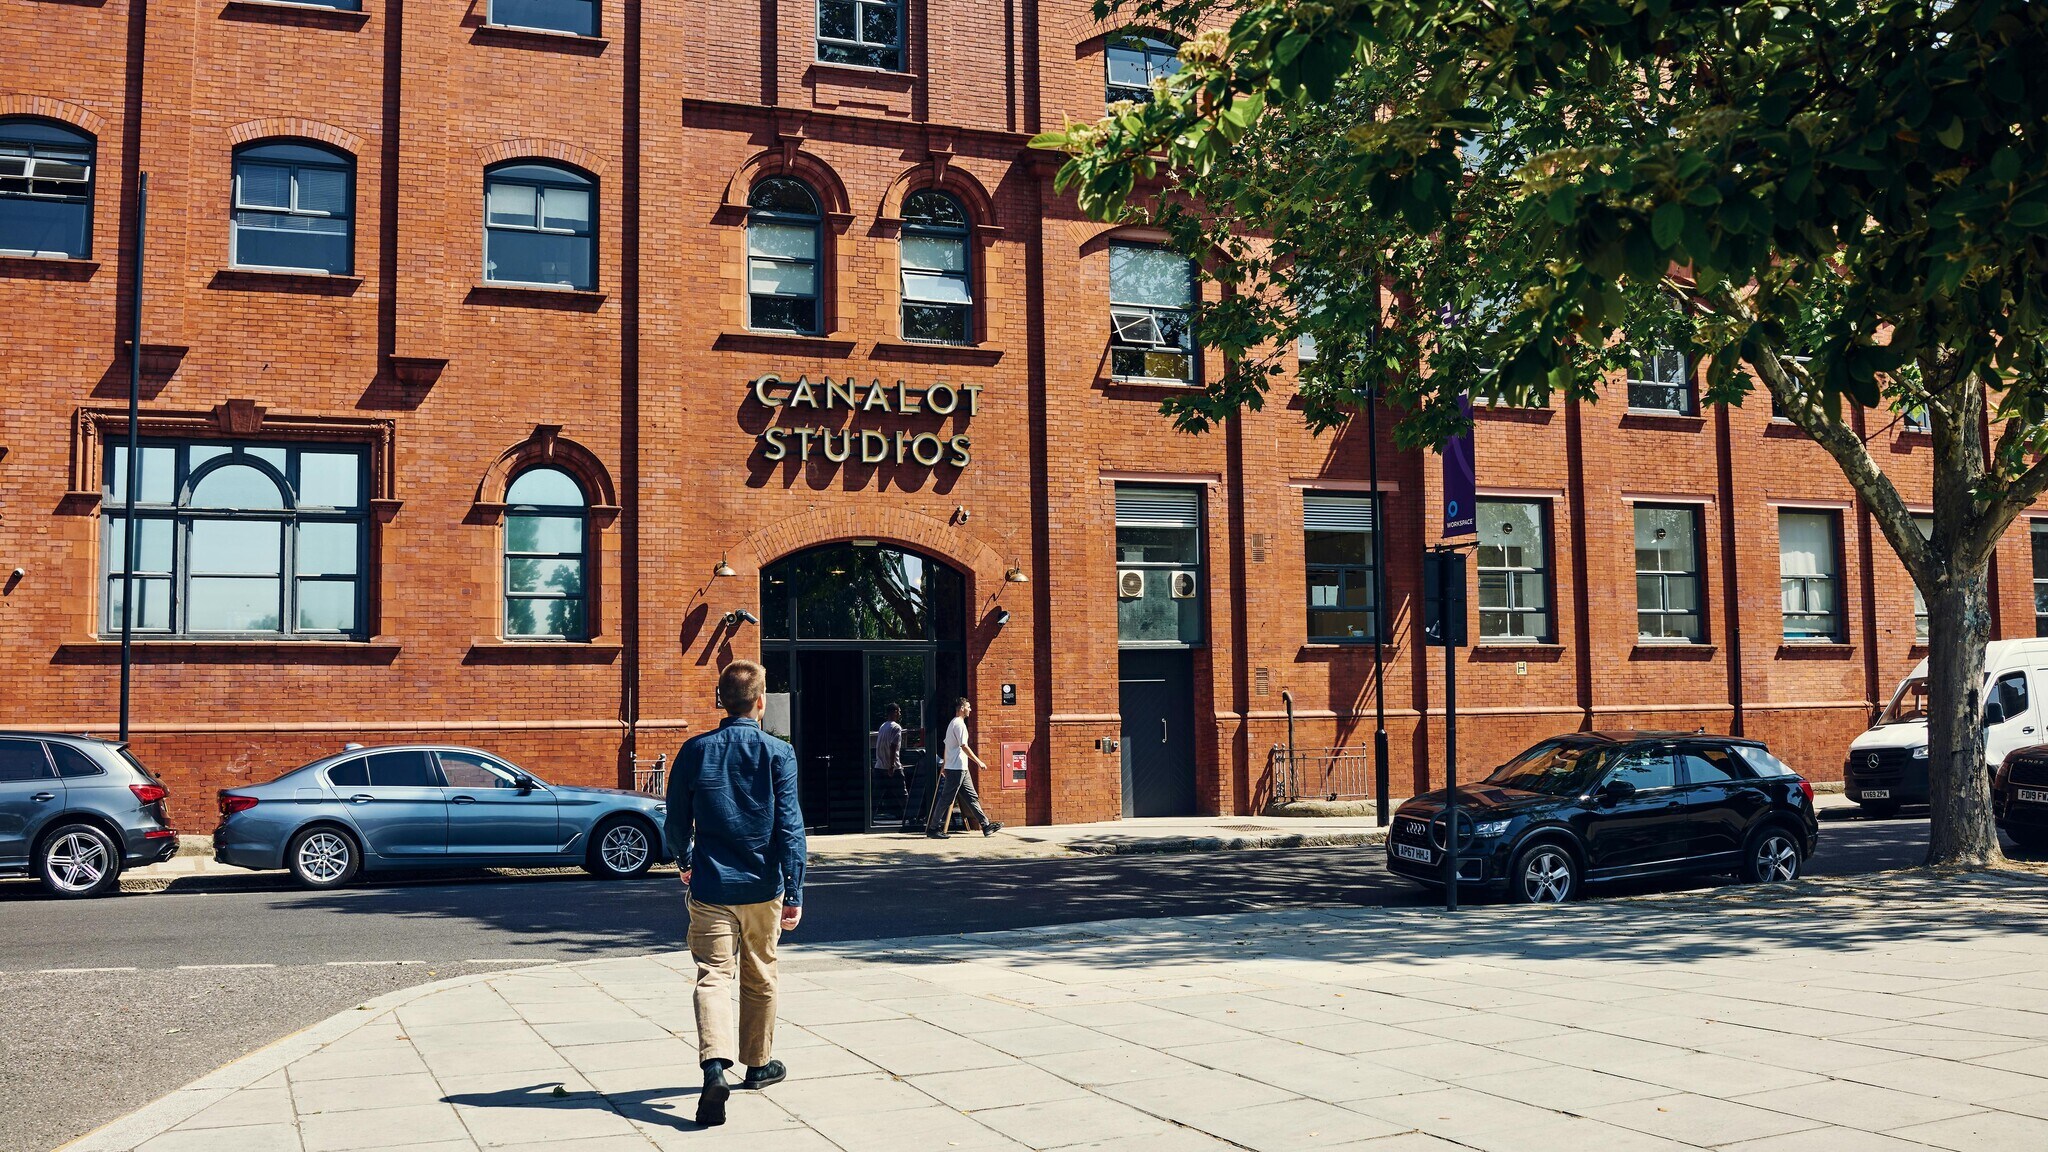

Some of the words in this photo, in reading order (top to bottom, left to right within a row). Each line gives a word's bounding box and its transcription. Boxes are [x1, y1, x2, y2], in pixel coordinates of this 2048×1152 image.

[755, 372, 984, 417] CANALOT
[764, 426, 971, 467] STUDIOS
[1446, 518, 1473, 529] WORKSPACE
